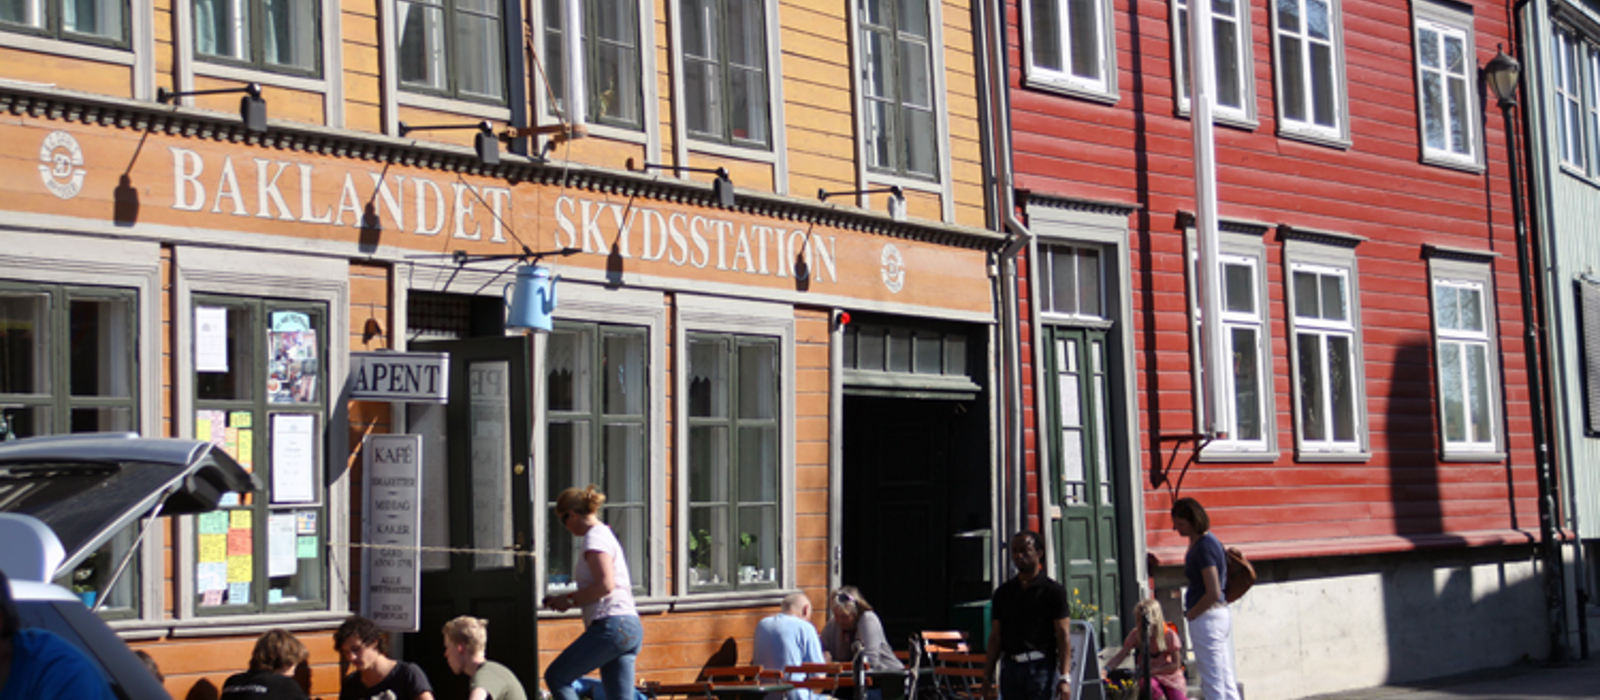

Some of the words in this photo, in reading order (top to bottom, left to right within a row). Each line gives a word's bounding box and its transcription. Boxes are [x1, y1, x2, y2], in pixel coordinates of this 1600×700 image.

[168, 146, 512, 243] BAKLANDET
[554, 195, 838, 284] SKYDSSTATION
[352, 356, 441, 395] ÅPENT
[374, 445, 412, 464] KAFÉ
